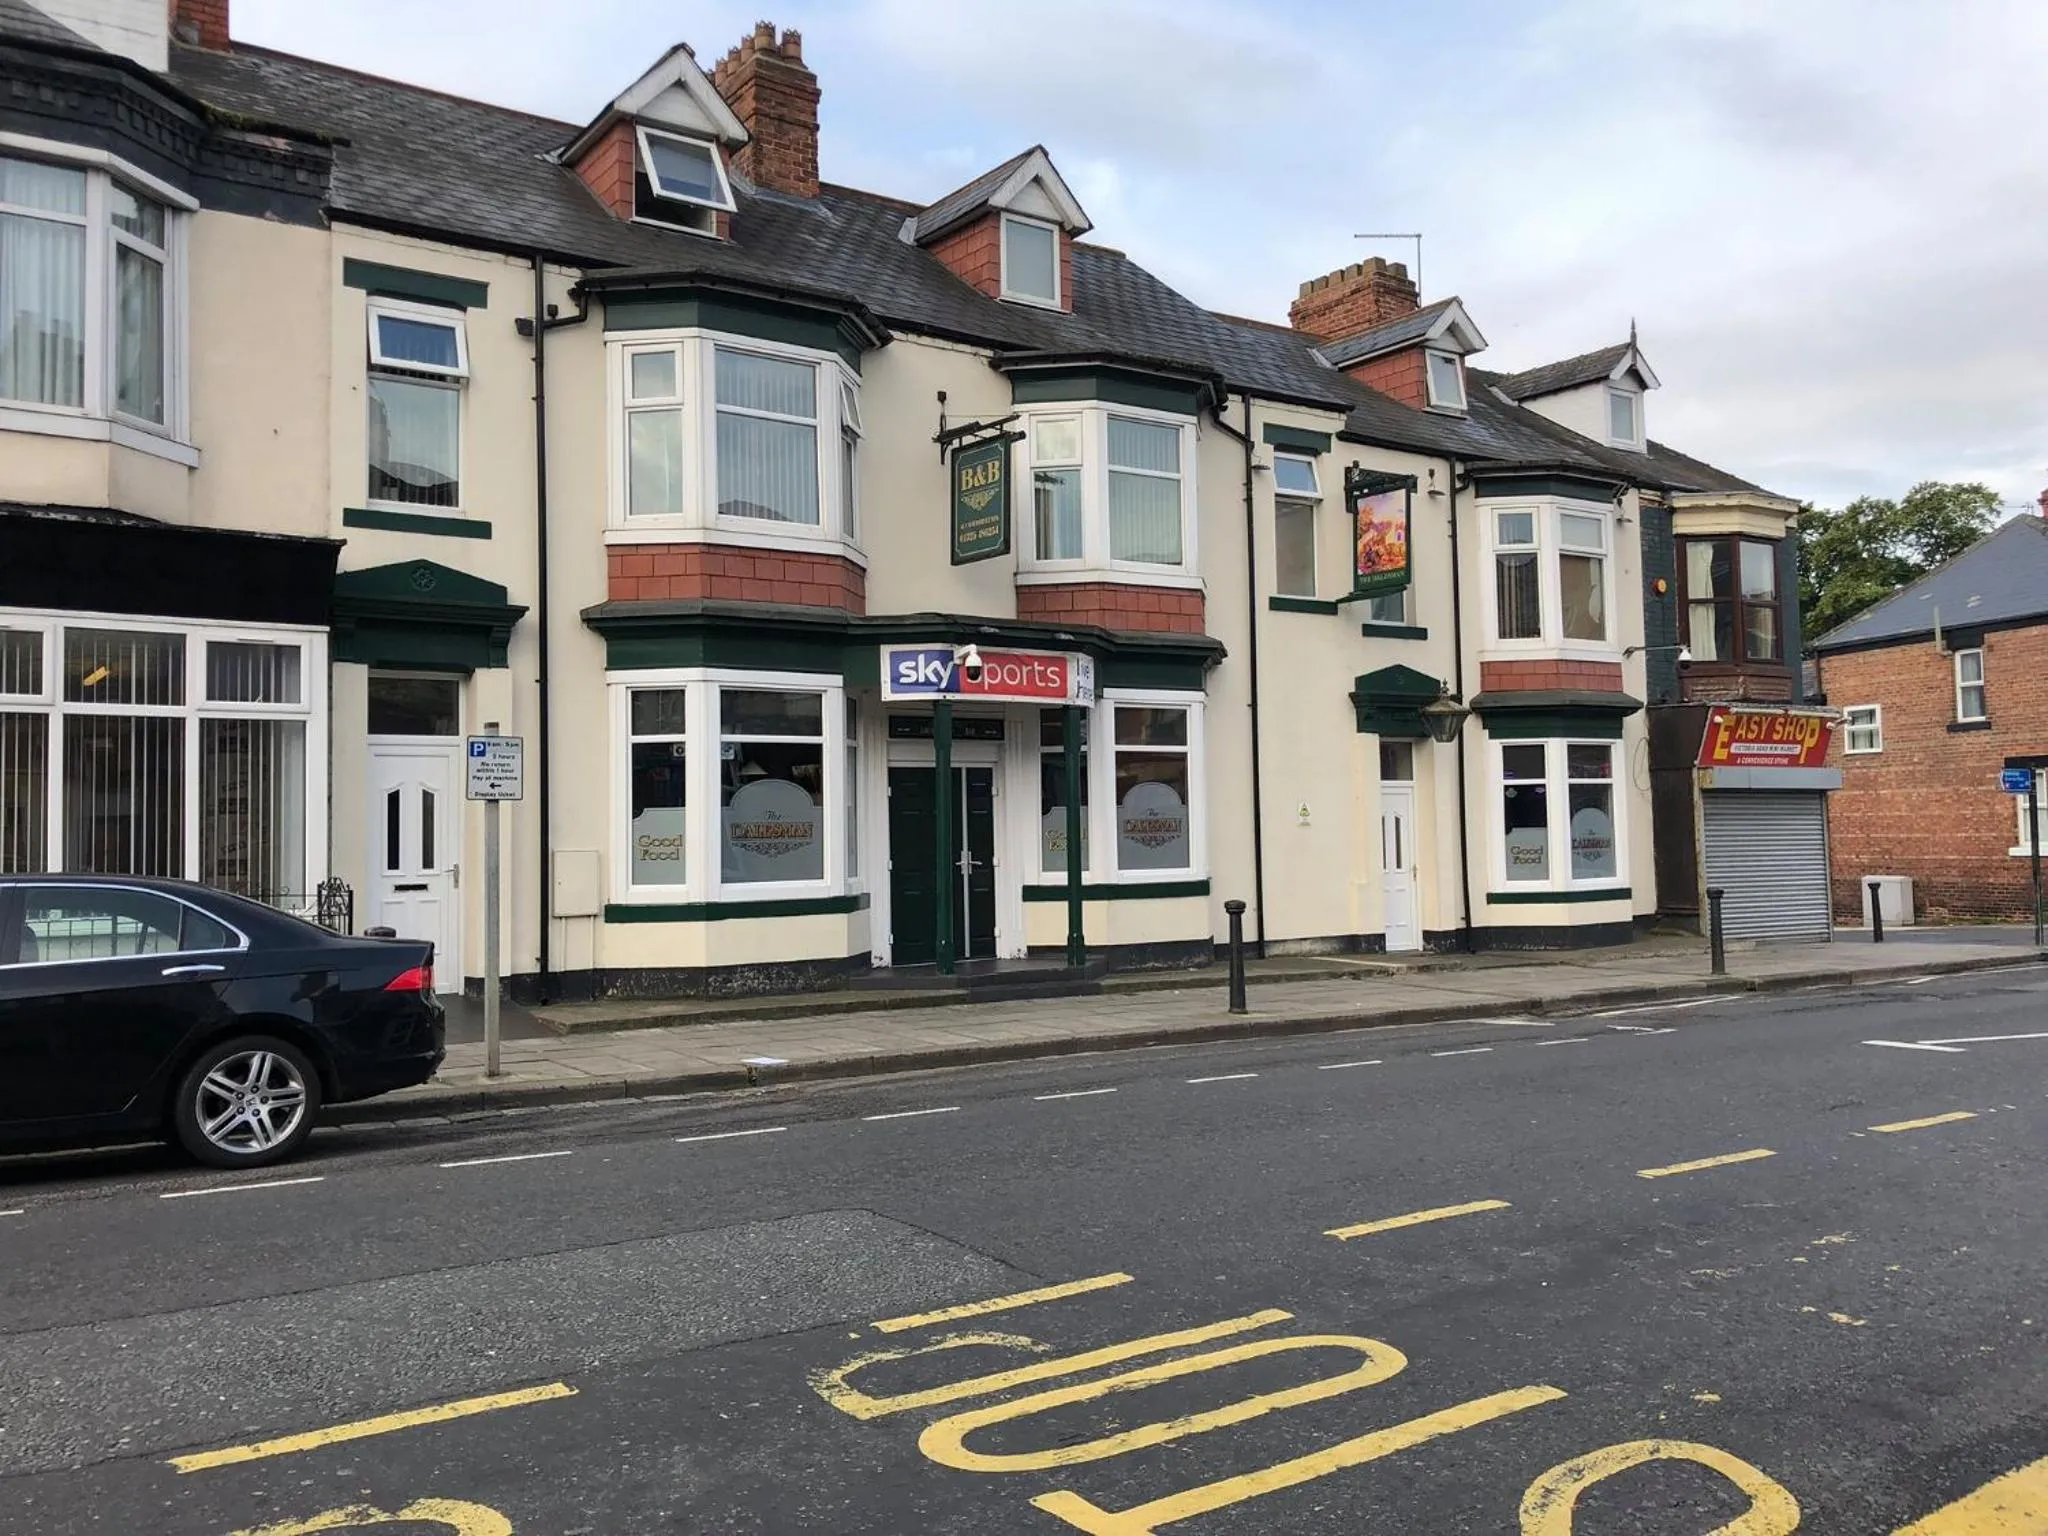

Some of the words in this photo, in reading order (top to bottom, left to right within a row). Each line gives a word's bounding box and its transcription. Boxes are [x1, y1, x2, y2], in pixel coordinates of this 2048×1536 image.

[962, 460, 1000, 491] B&B
[899, 653, 954, 689] sky
[966, 661, 1061, 690] ports
[1713, 714, 1772, 760] EASY
[1772, 716, 1820, 764] SHOP
[731, 823, 814, 841] DALESMAN
[639, 834, 684, 849] Good
[640, 849, 681, 862] Food
[1510, 846, 1544, 856] Good
[1512, 856, 1542, 865] Food
